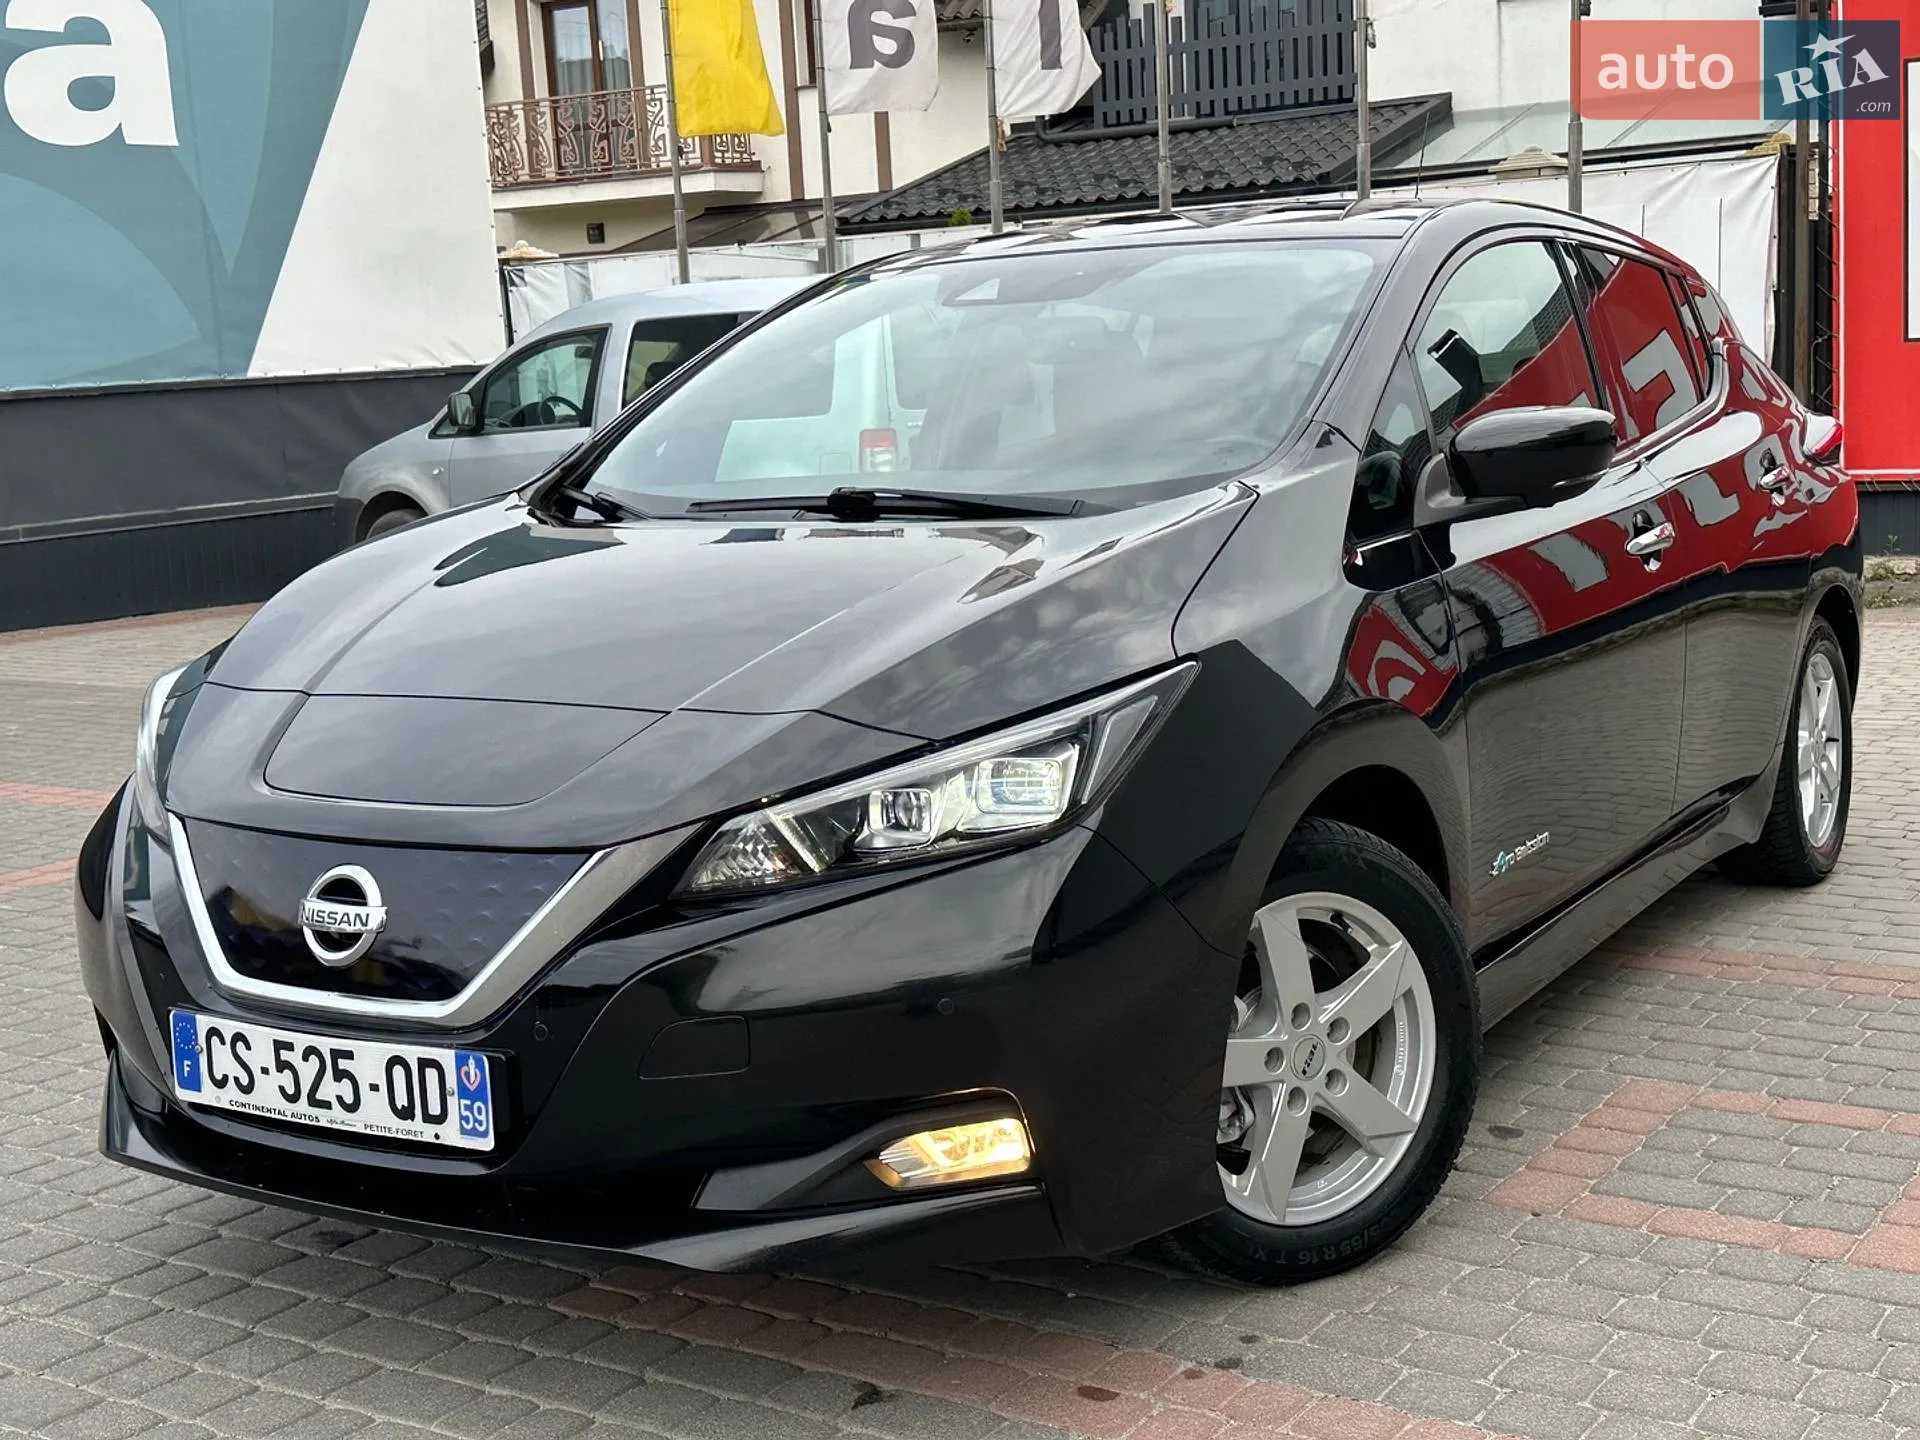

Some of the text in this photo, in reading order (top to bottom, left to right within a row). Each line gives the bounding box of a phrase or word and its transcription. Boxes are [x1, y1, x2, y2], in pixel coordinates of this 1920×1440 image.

[4, 0, 179, 147] a
[302, 907, 370, 928] NISSAN
[182, 1060, 192, 1077] F
[204, 1026, 449, 1126] CS-525-QD
[228, 1099, 289, 1118] CONTINENTAL
[290, 1111, 320, 1123] AUTOS
[460, 1098, 486, 1133] 59
